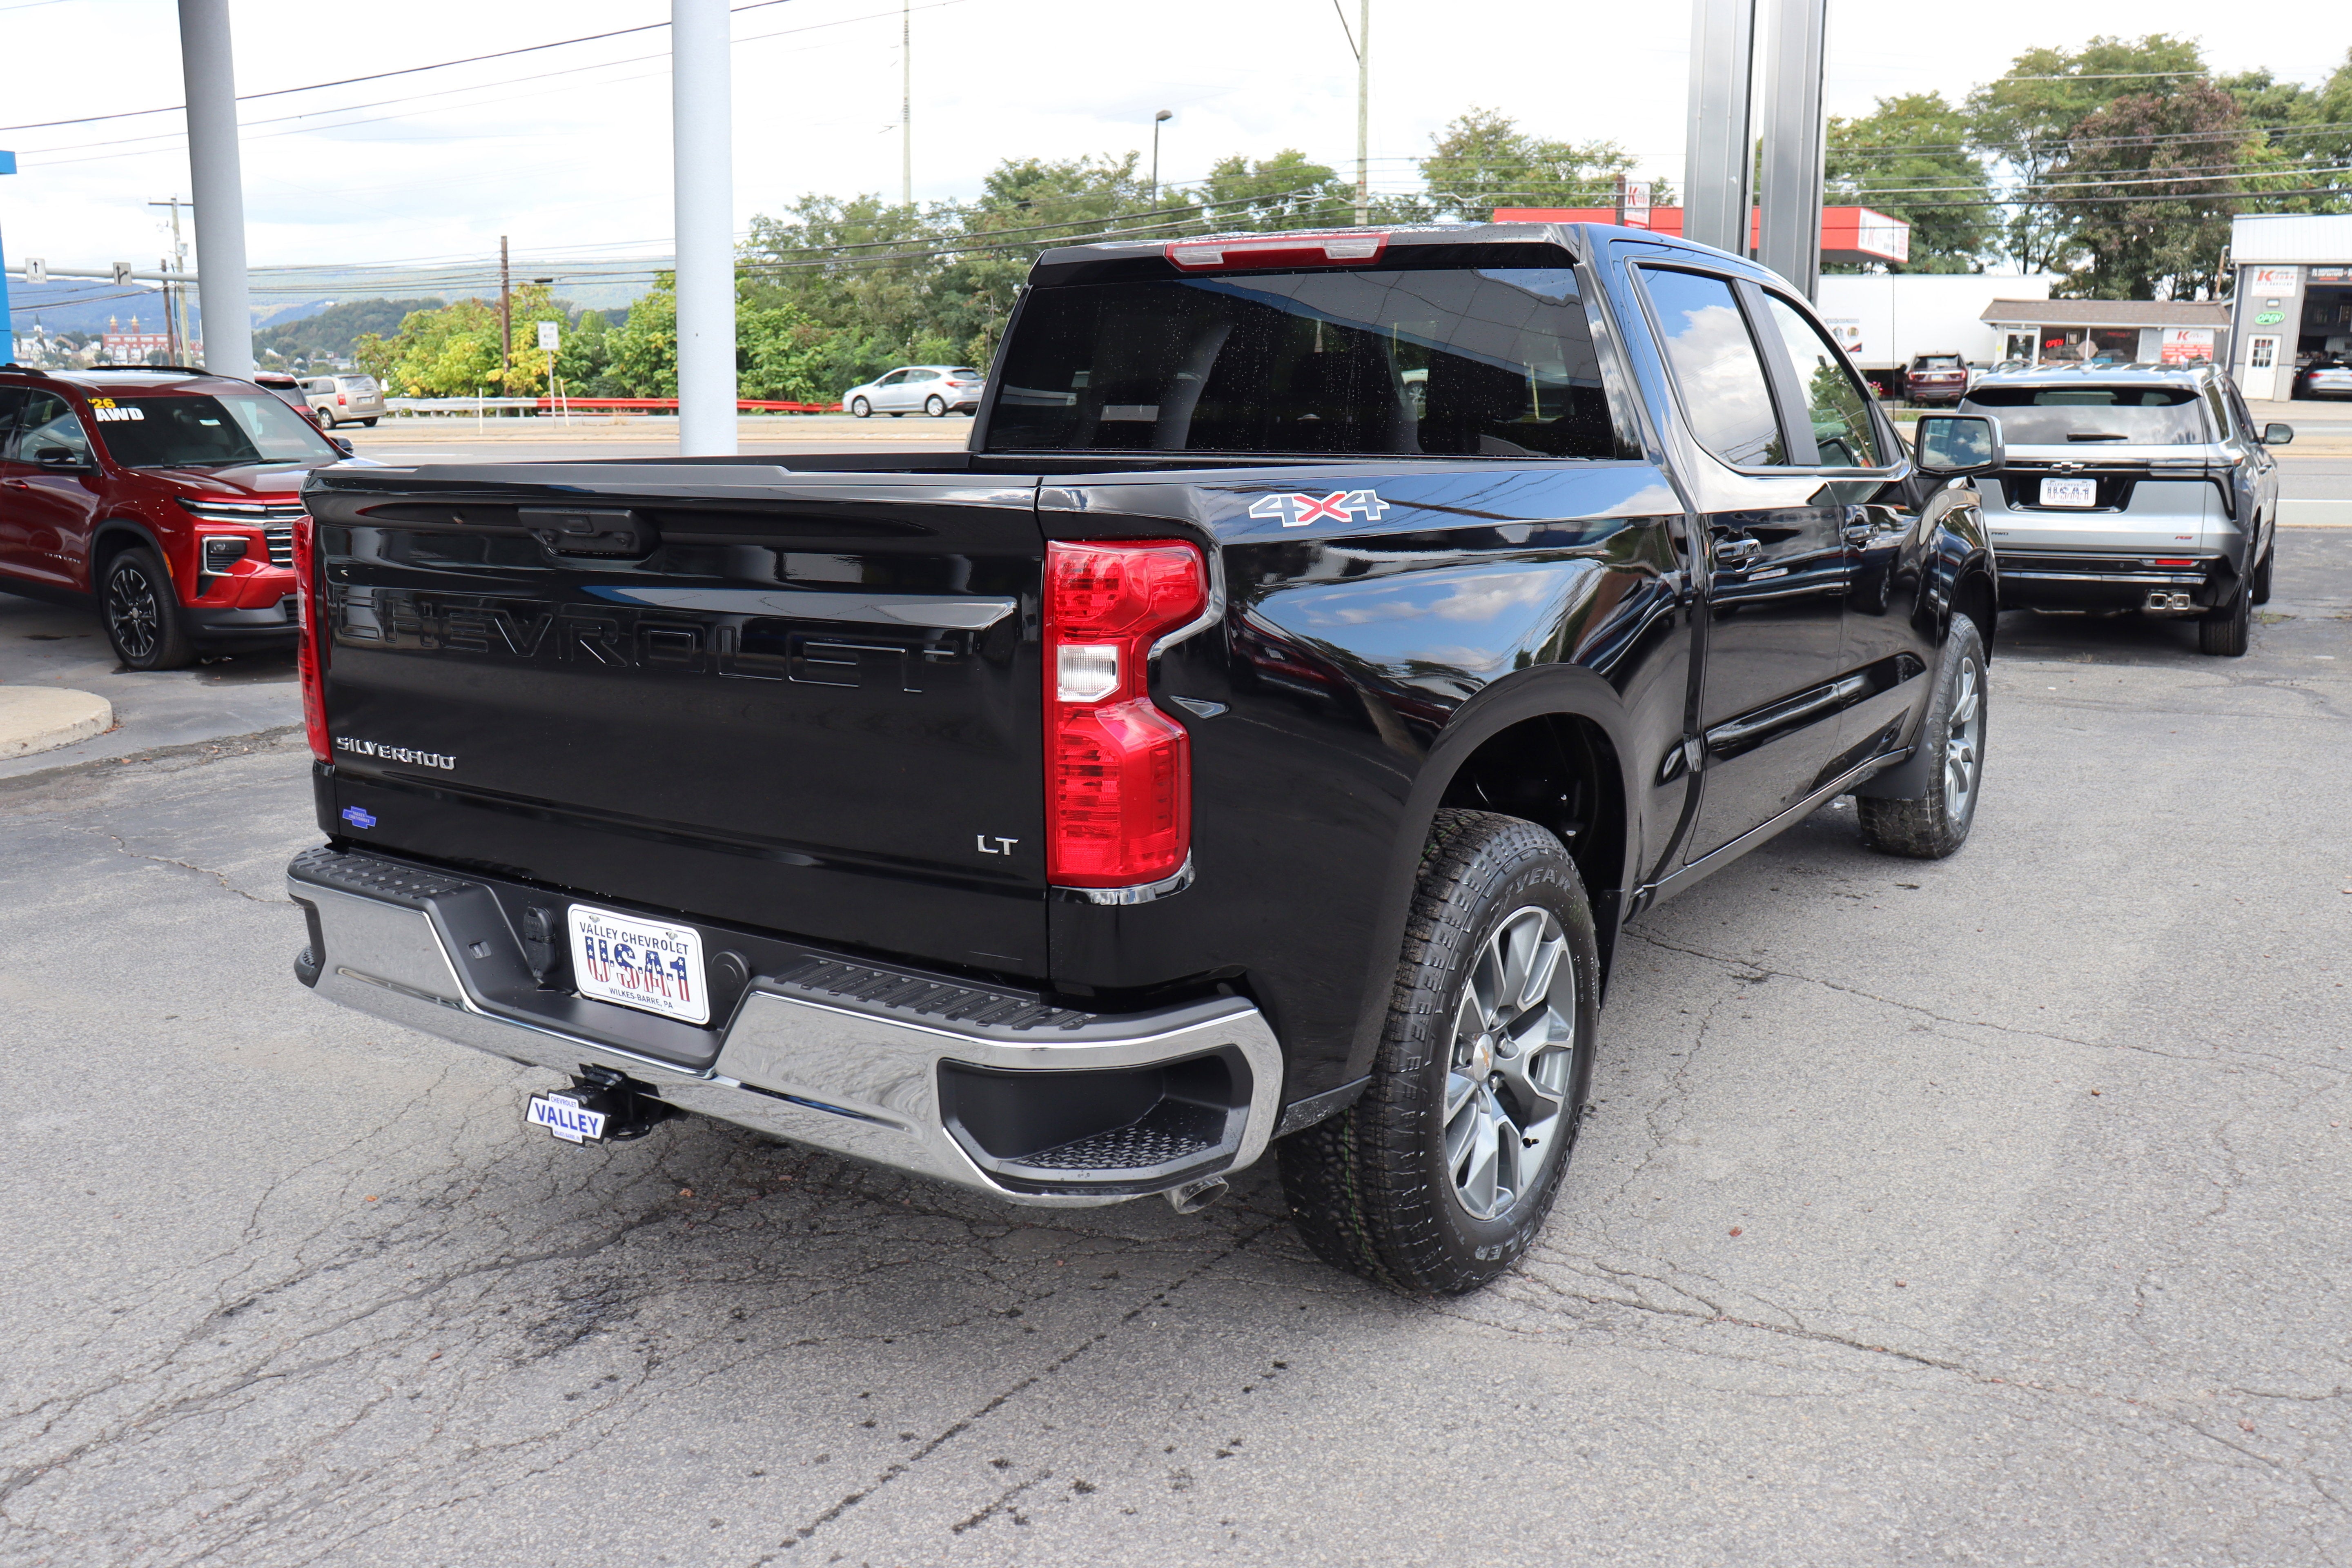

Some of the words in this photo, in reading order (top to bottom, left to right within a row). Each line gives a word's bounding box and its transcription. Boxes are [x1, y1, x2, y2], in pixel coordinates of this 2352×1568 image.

[2258, 313, 2283, 323] OPEN
[2045, 339, 2064, 348] OPEN
[87, 398, 116, 409] '26
[95, 408, 145, 422] AWD
[336, 594, 959, 694] CHEVROLET
[336, 736, 457, 770] SILVERADO
[976, 834, 1019, 856] LT
[579, 921, 617, 940] VALLEY
[621, 931, 688, 955] CHEVROLET
[609, 987, 662, 1007] WILKES-BARRE,
[664, 1000, 673, 1009] PA
[550, 1096, 577, 1108] CHEVROLET
[535, 1102, 599, 1136] VALLEY
